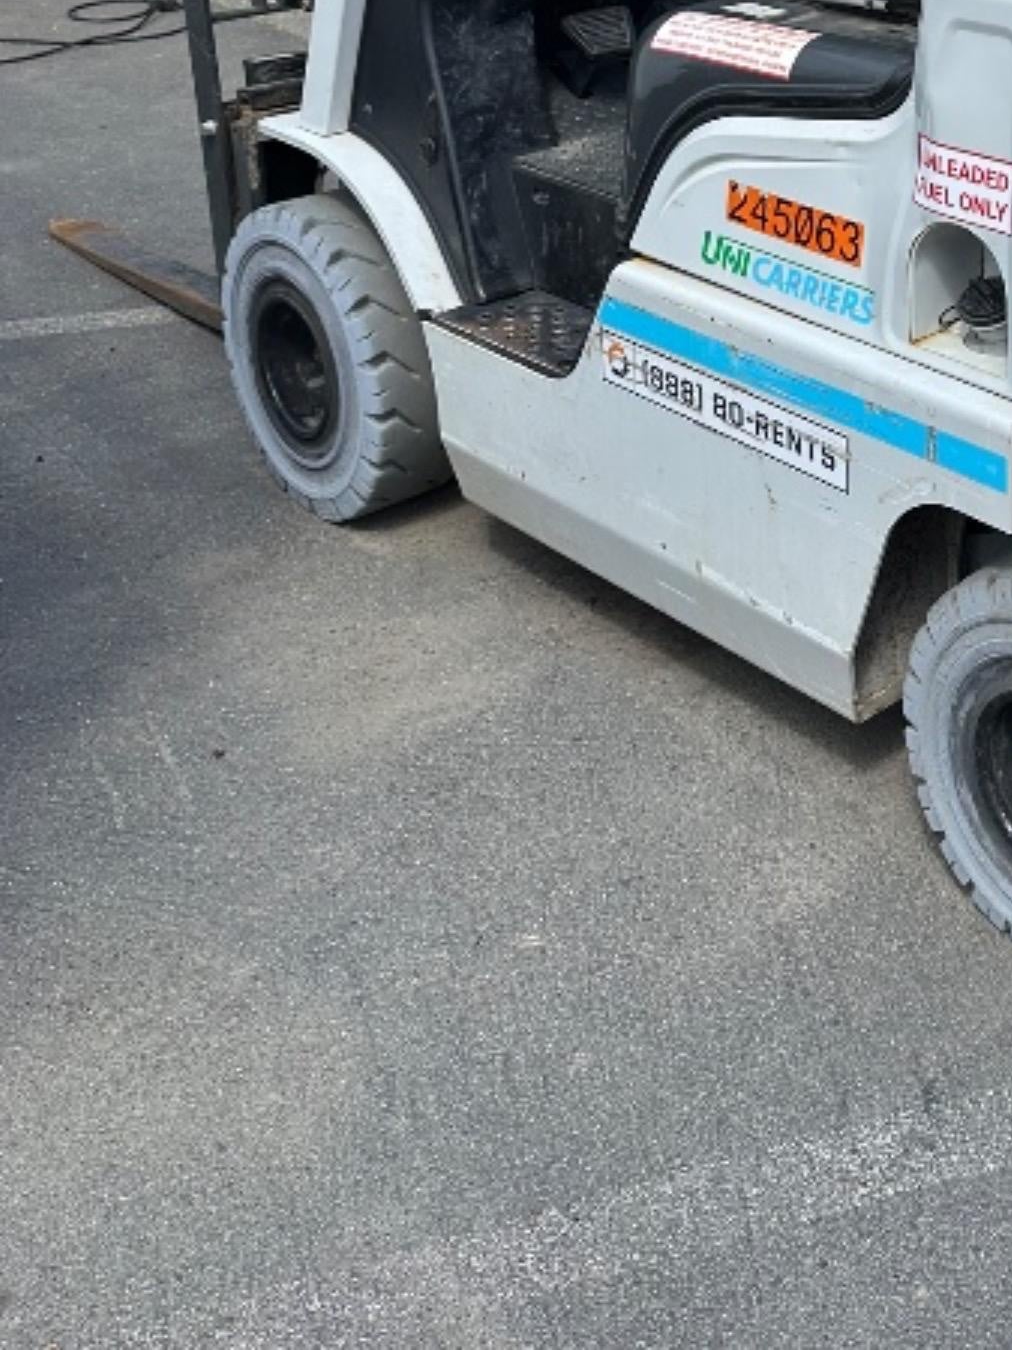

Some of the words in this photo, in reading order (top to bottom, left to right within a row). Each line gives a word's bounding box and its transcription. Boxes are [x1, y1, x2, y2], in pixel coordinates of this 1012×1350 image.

[917, 176, 955, 208] UEL
[959, 191, 1009, 223] ONLY
[922, 152, 1009, 192] NLEADED
[727, 180, 861, 263] 245063
[701, 230, 875, 325] UNICARRIERS
[641, 358, 703, 413] (888)
